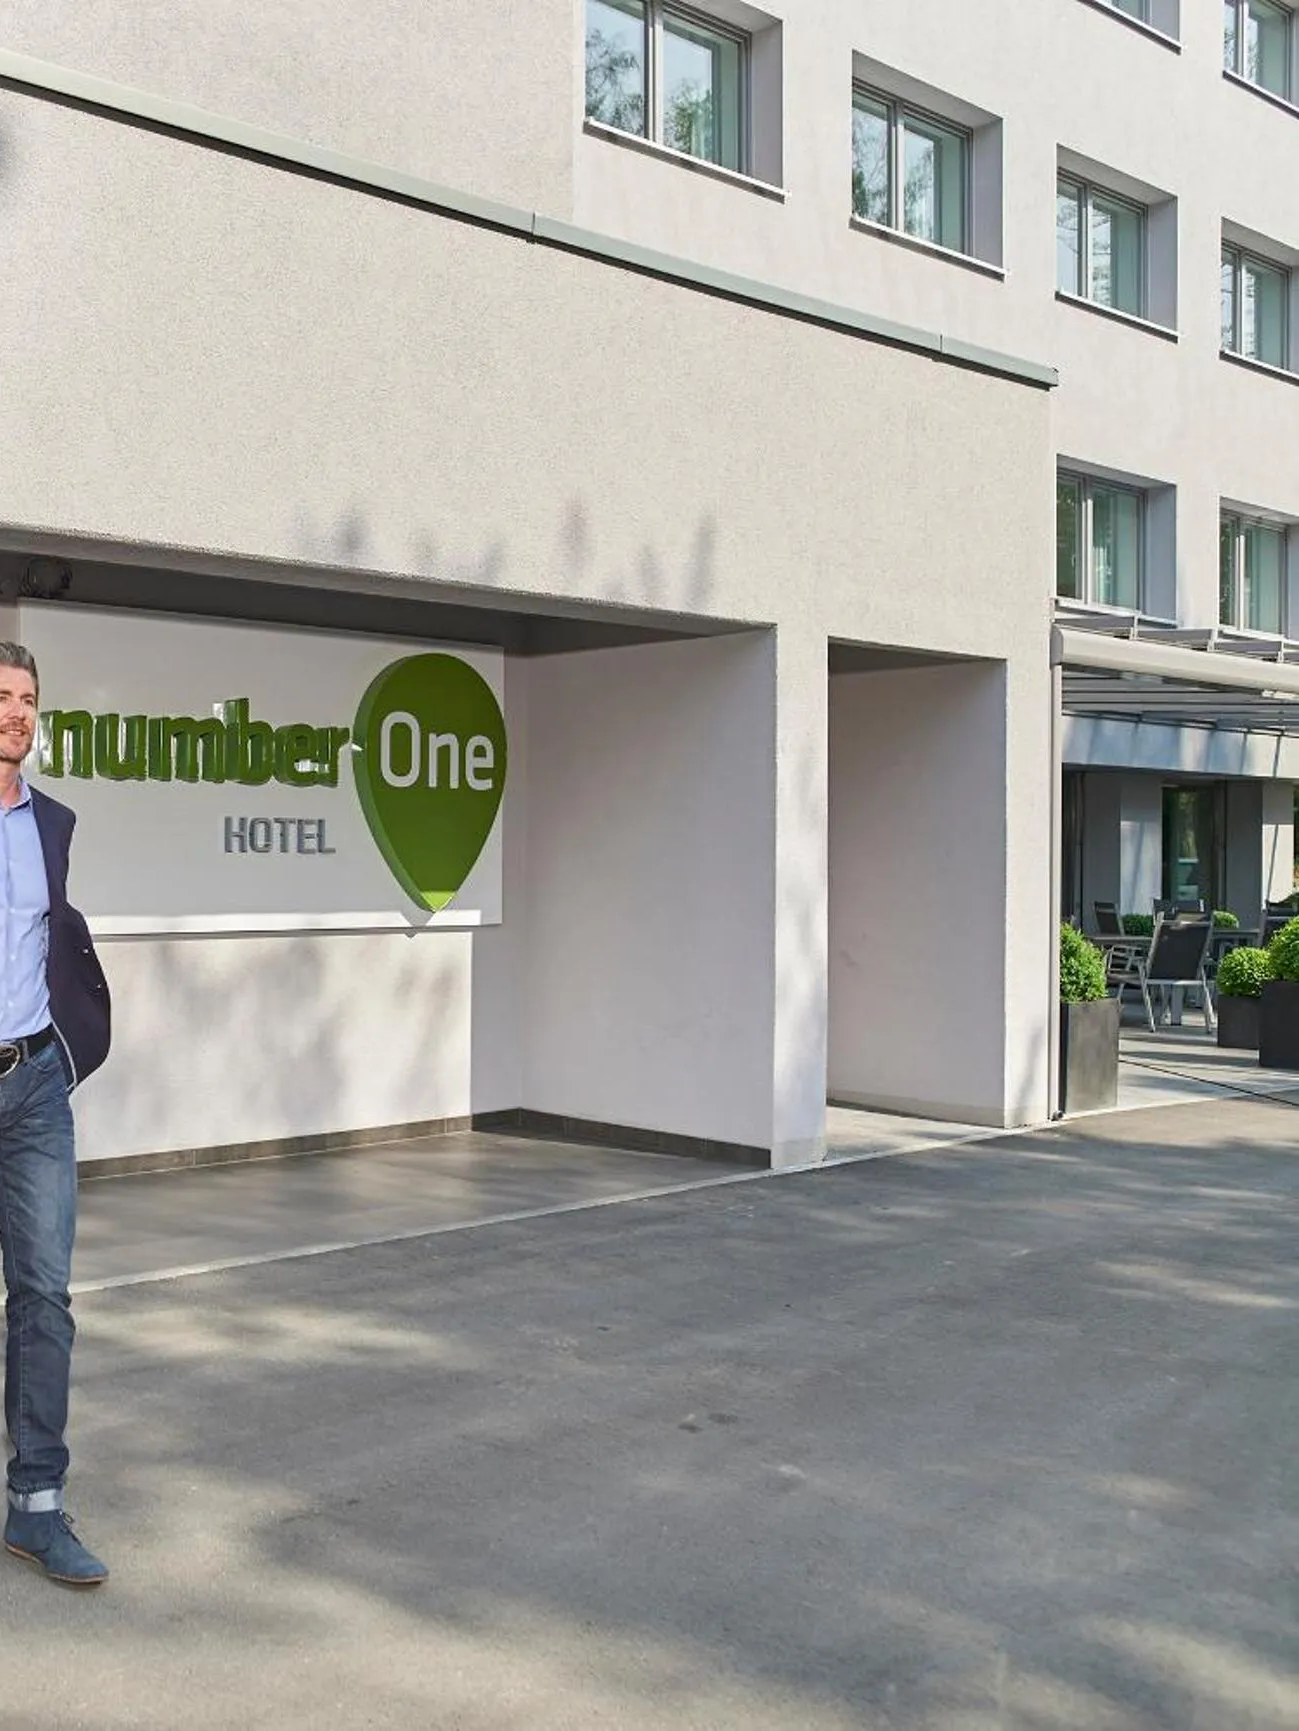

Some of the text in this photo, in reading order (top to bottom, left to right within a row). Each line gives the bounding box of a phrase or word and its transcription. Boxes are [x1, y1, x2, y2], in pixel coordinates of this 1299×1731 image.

[37, 697, 494, 790] number One
[224, 816, 335, 854] HOTEL
